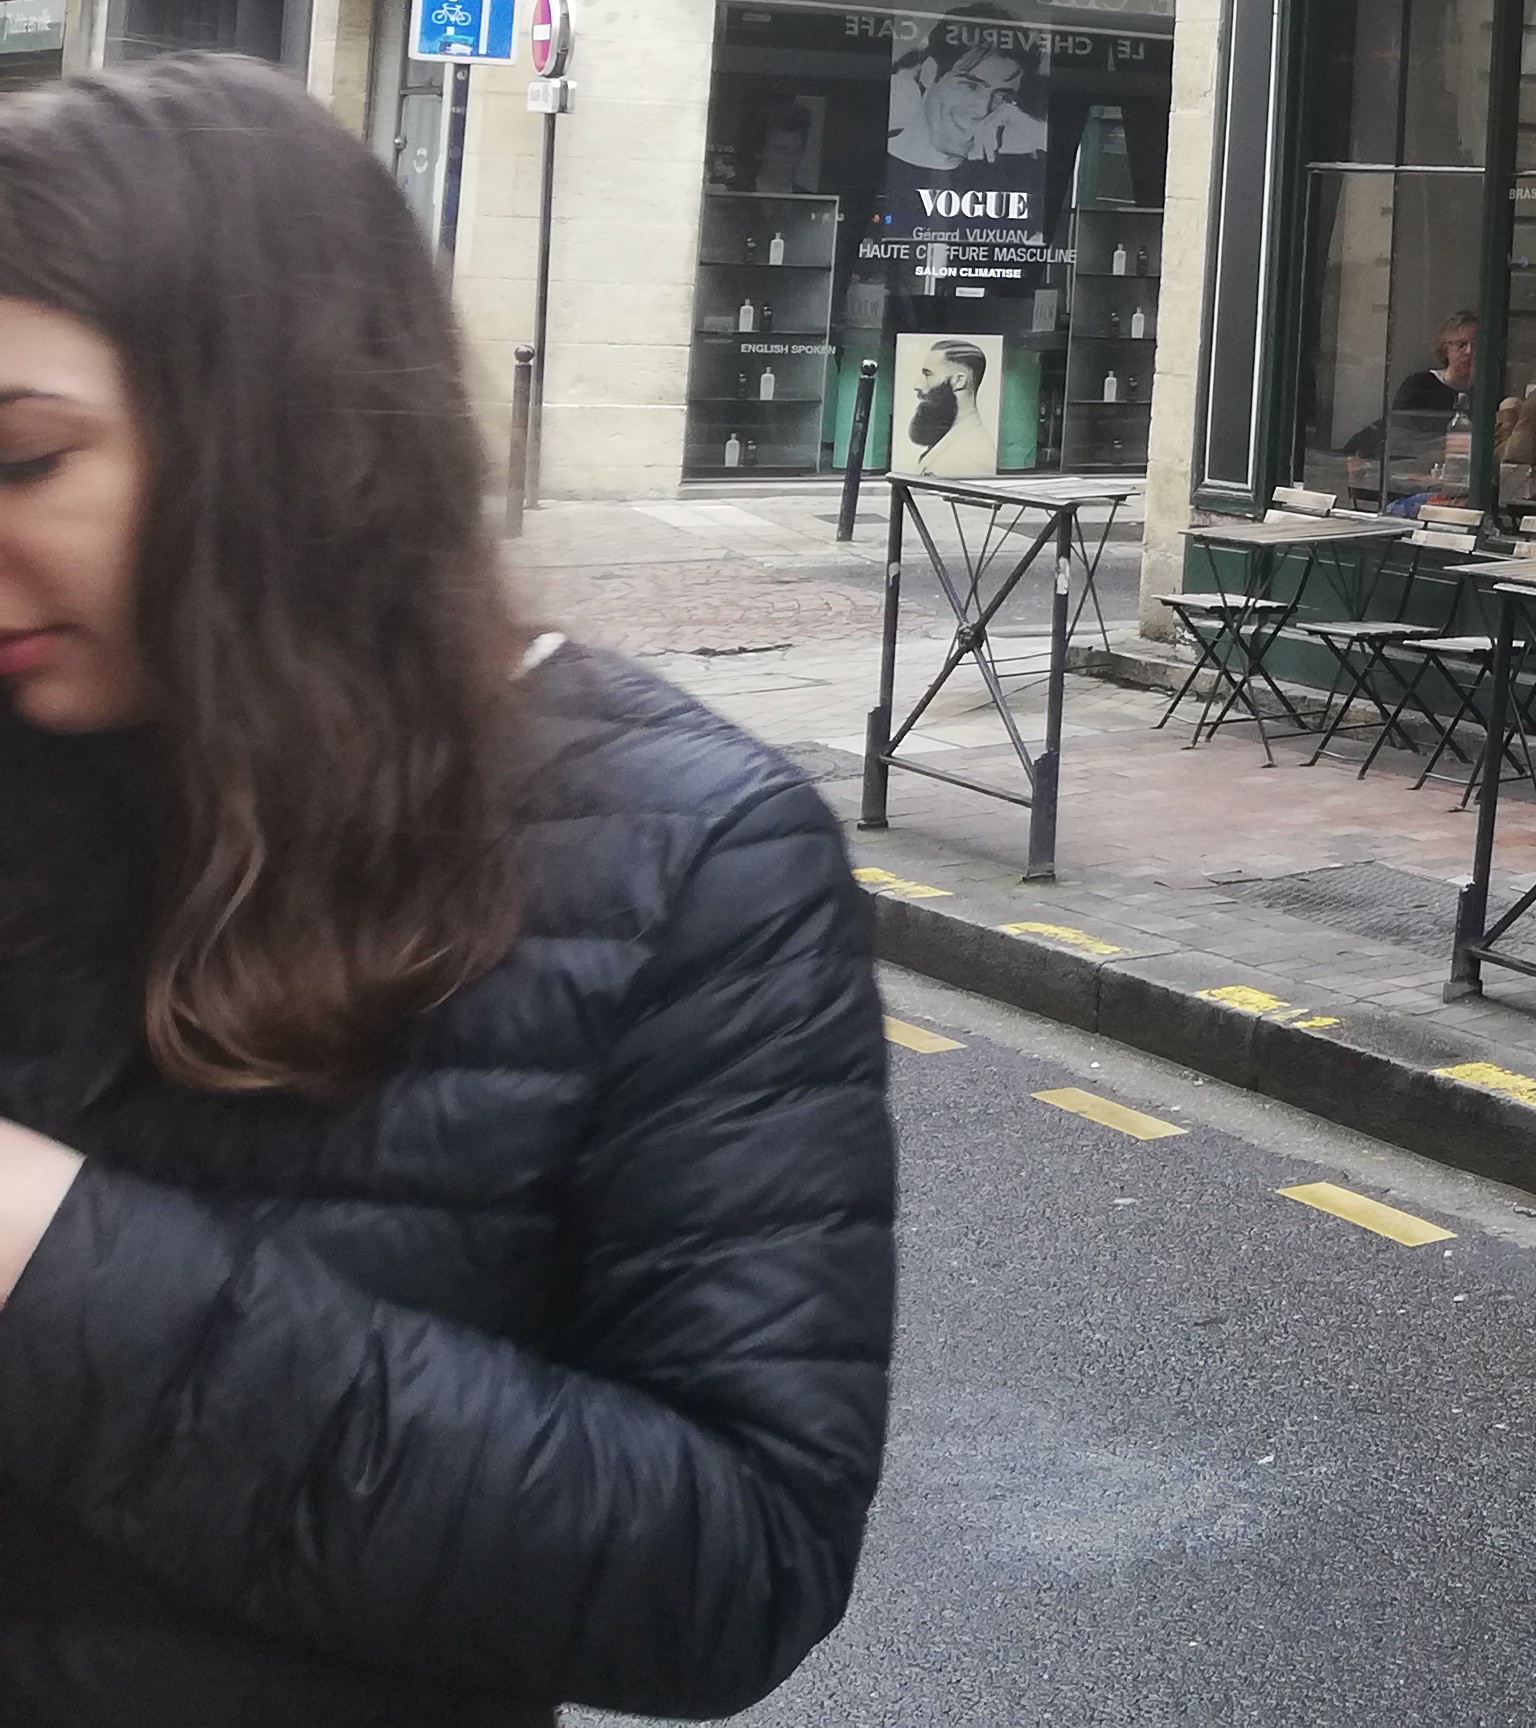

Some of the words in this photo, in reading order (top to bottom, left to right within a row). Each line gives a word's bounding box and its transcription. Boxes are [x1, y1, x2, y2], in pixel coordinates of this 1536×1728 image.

[916, 188, 1030, 220] VOGUE
[912, 226, 960, 241] Gérard
[966, 228, 1028, 243] VUXUAN
[858, 243, 910, 259] HAUTE
[915, 244, 988, 261] CFFURE
[993, 246, 1078, 264] MASCULINE
[915, 266, 957, 278] SALON
[740, 343, 789, 354] ENGLISH
[791, 344, 837, 355] SPOKEN
